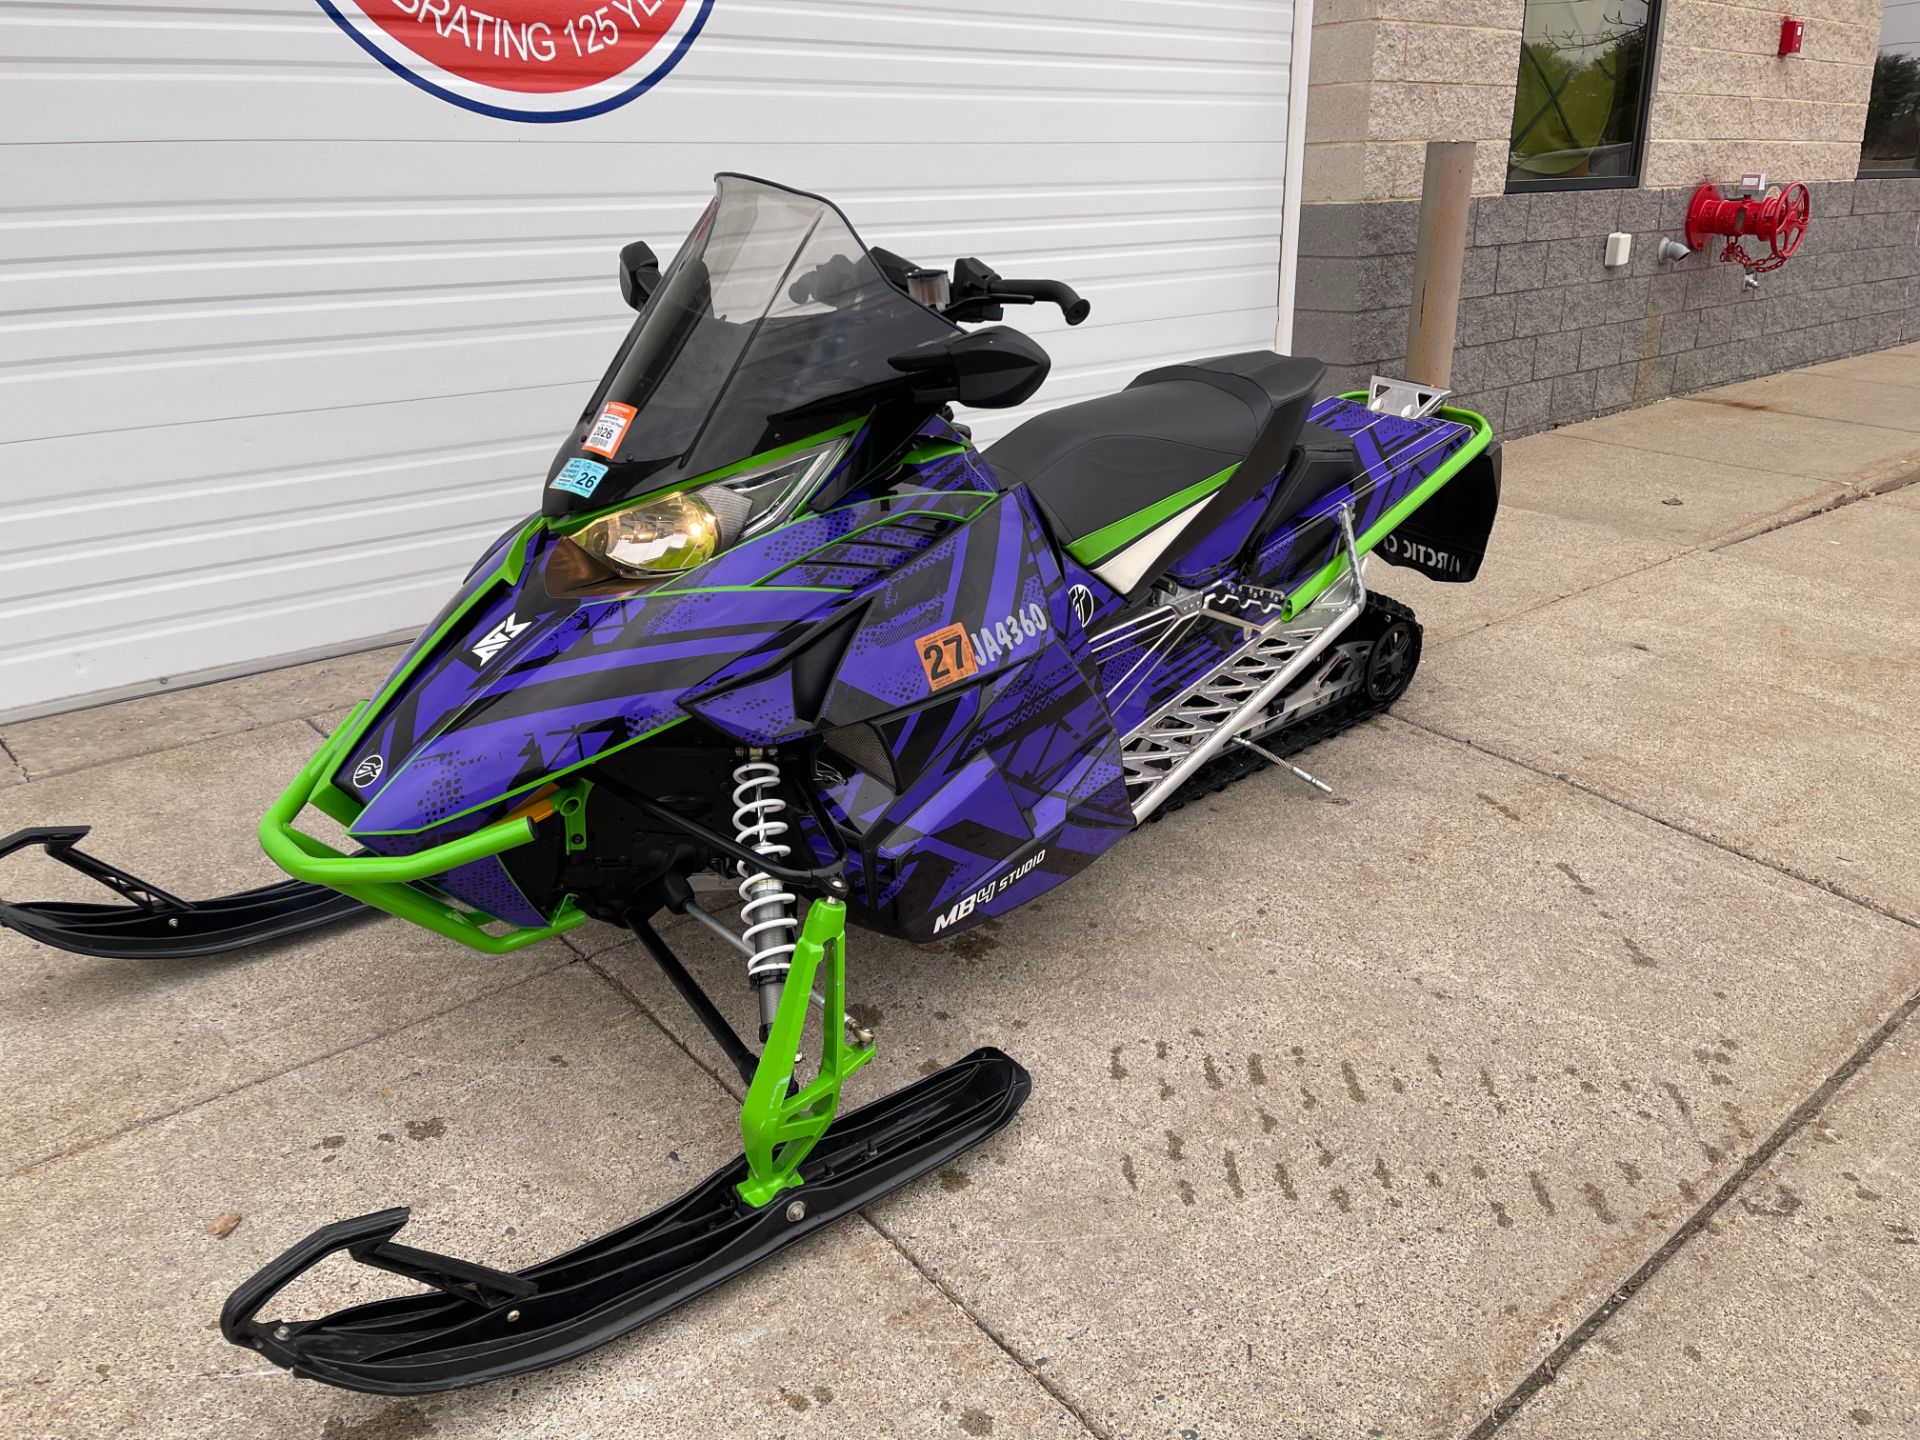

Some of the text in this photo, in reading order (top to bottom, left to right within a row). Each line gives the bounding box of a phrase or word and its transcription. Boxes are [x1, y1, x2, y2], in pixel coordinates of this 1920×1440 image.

[564, 7, 620, 58] 125
[575, 471, 597, 489] 26
[924, 634, 965, 682] 27
[971, 602, 1048, 667] JA4360
[932, 849, 1046, 935] MB4 STUDIO
